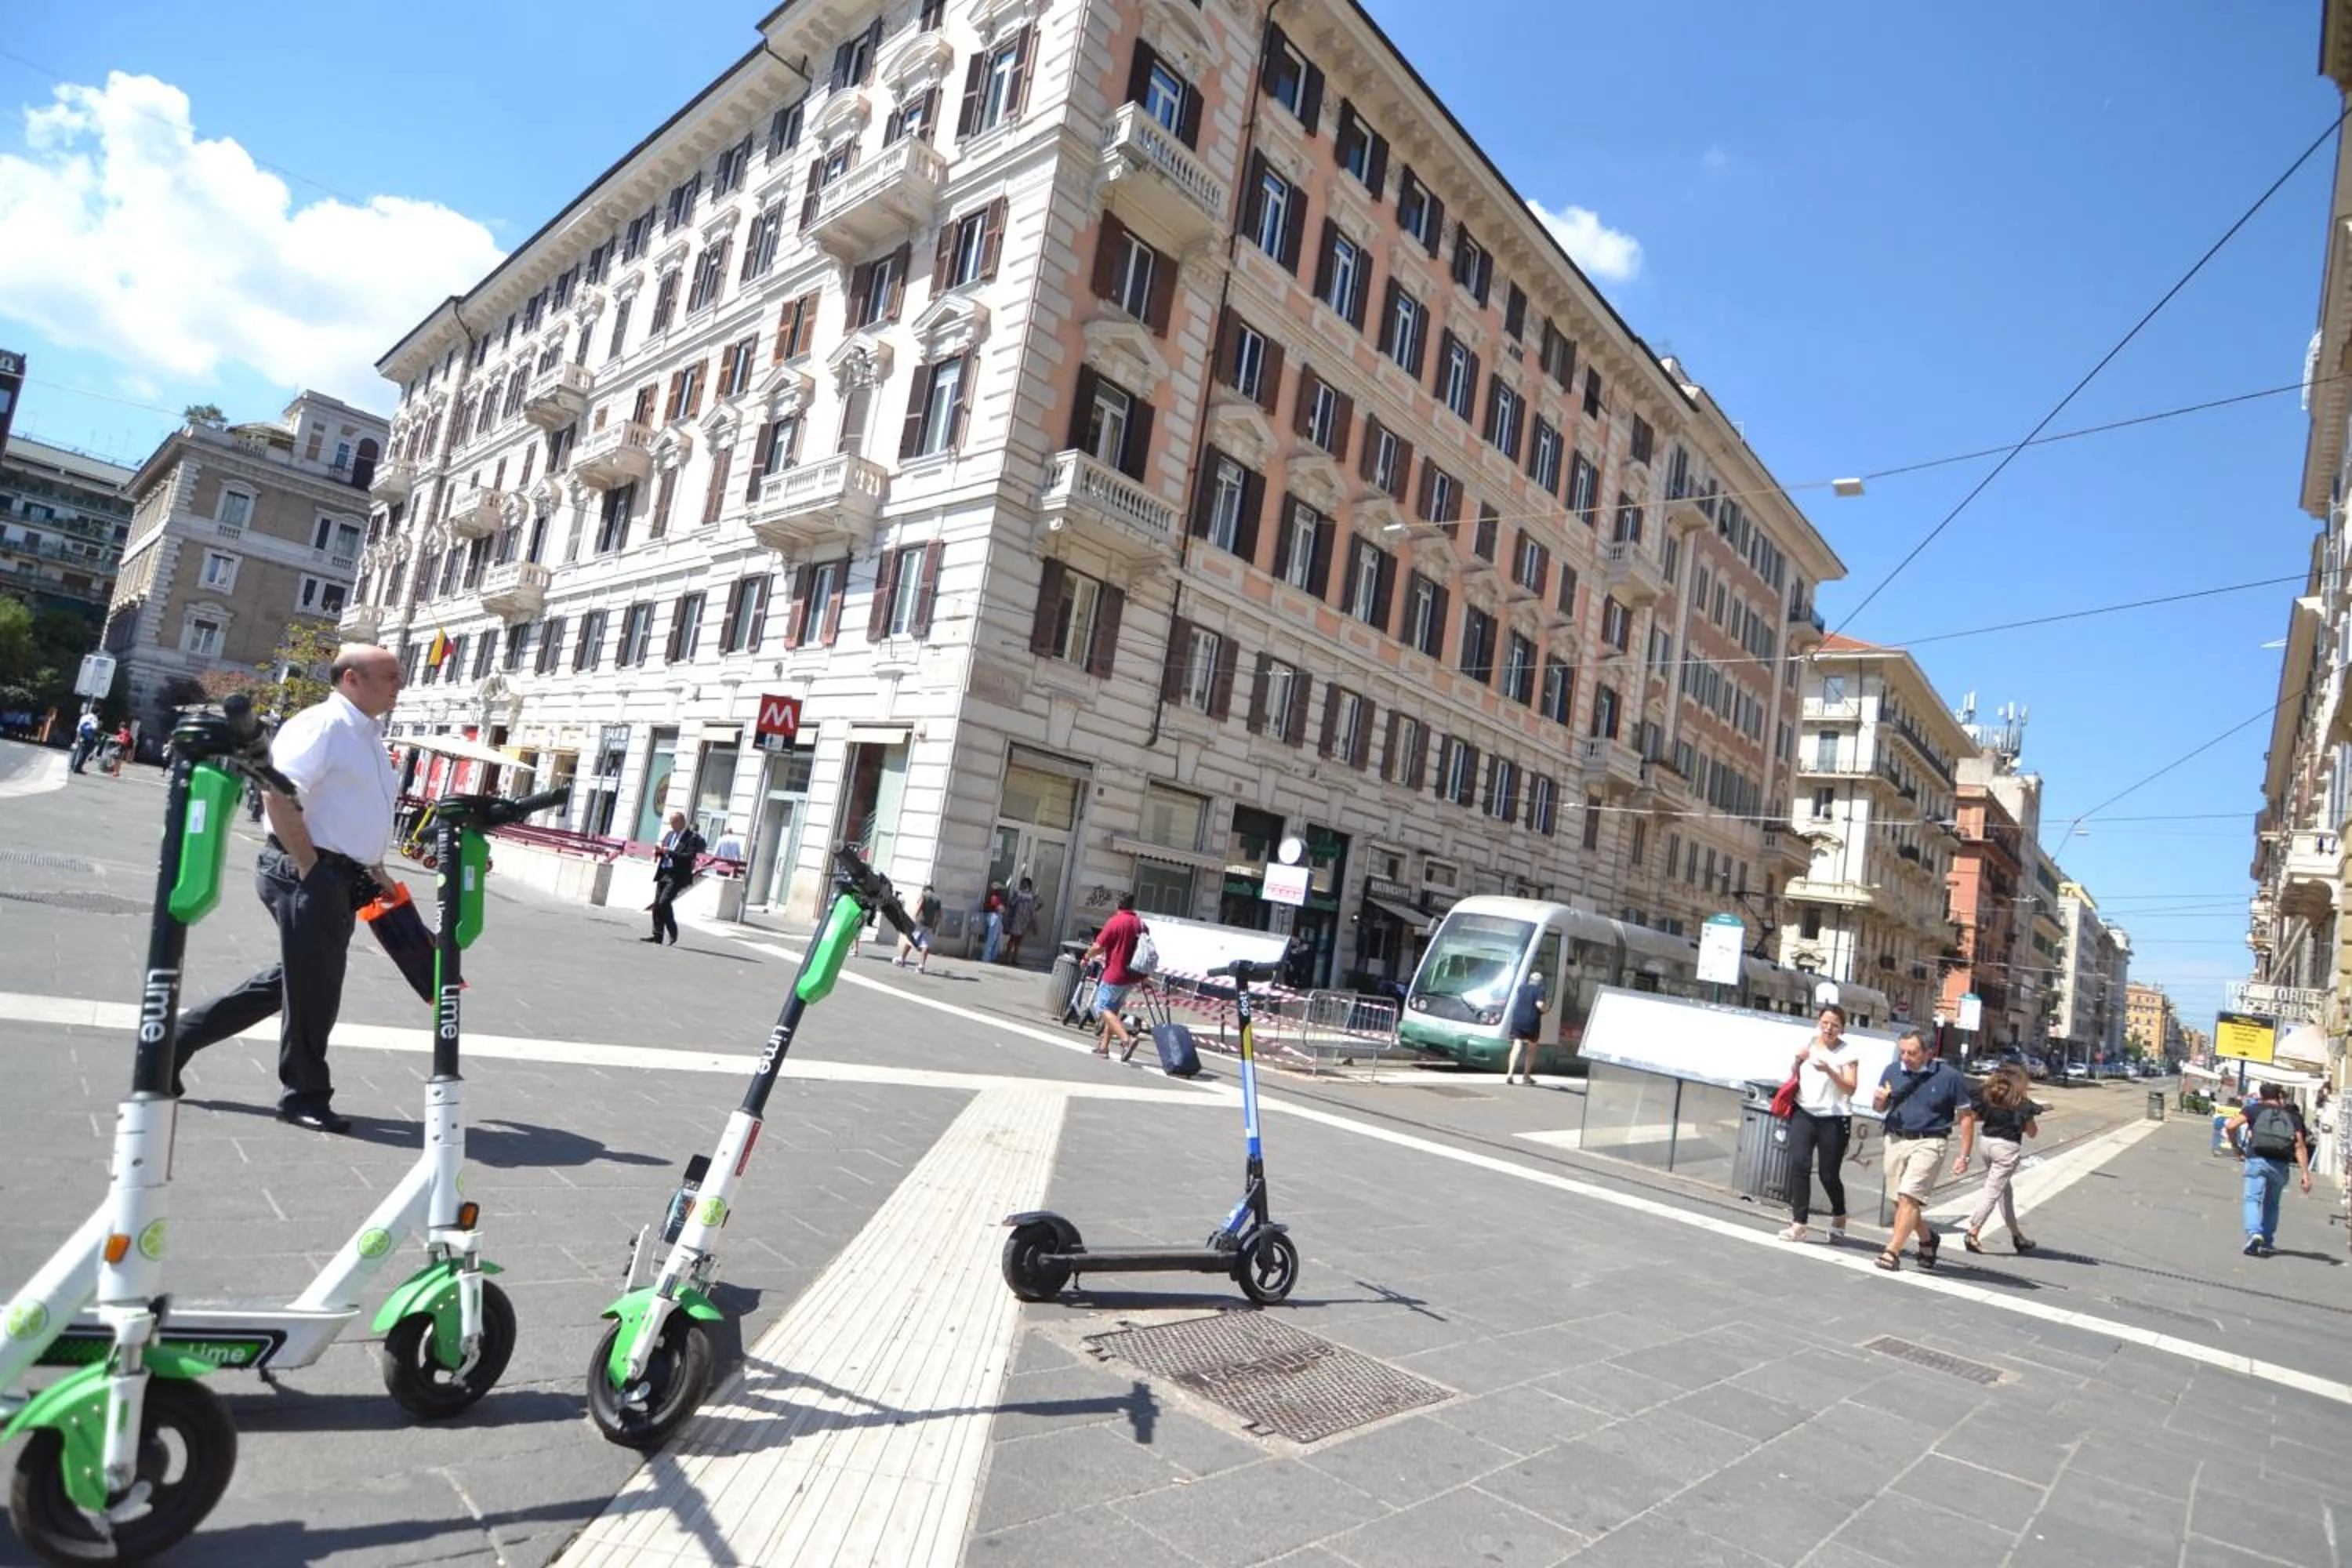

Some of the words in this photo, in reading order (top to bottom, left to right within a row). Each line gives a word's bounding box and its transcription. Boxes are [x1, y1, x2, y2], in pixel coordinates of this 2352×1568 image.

[761, 702, 794, 729] M
[140, 968, 179, 1044] Lime
[440, 984, 460, 1040] Lime
[1240, 990, 1249, 1017] dott
[757, 1025, 791, 1075] Lime
